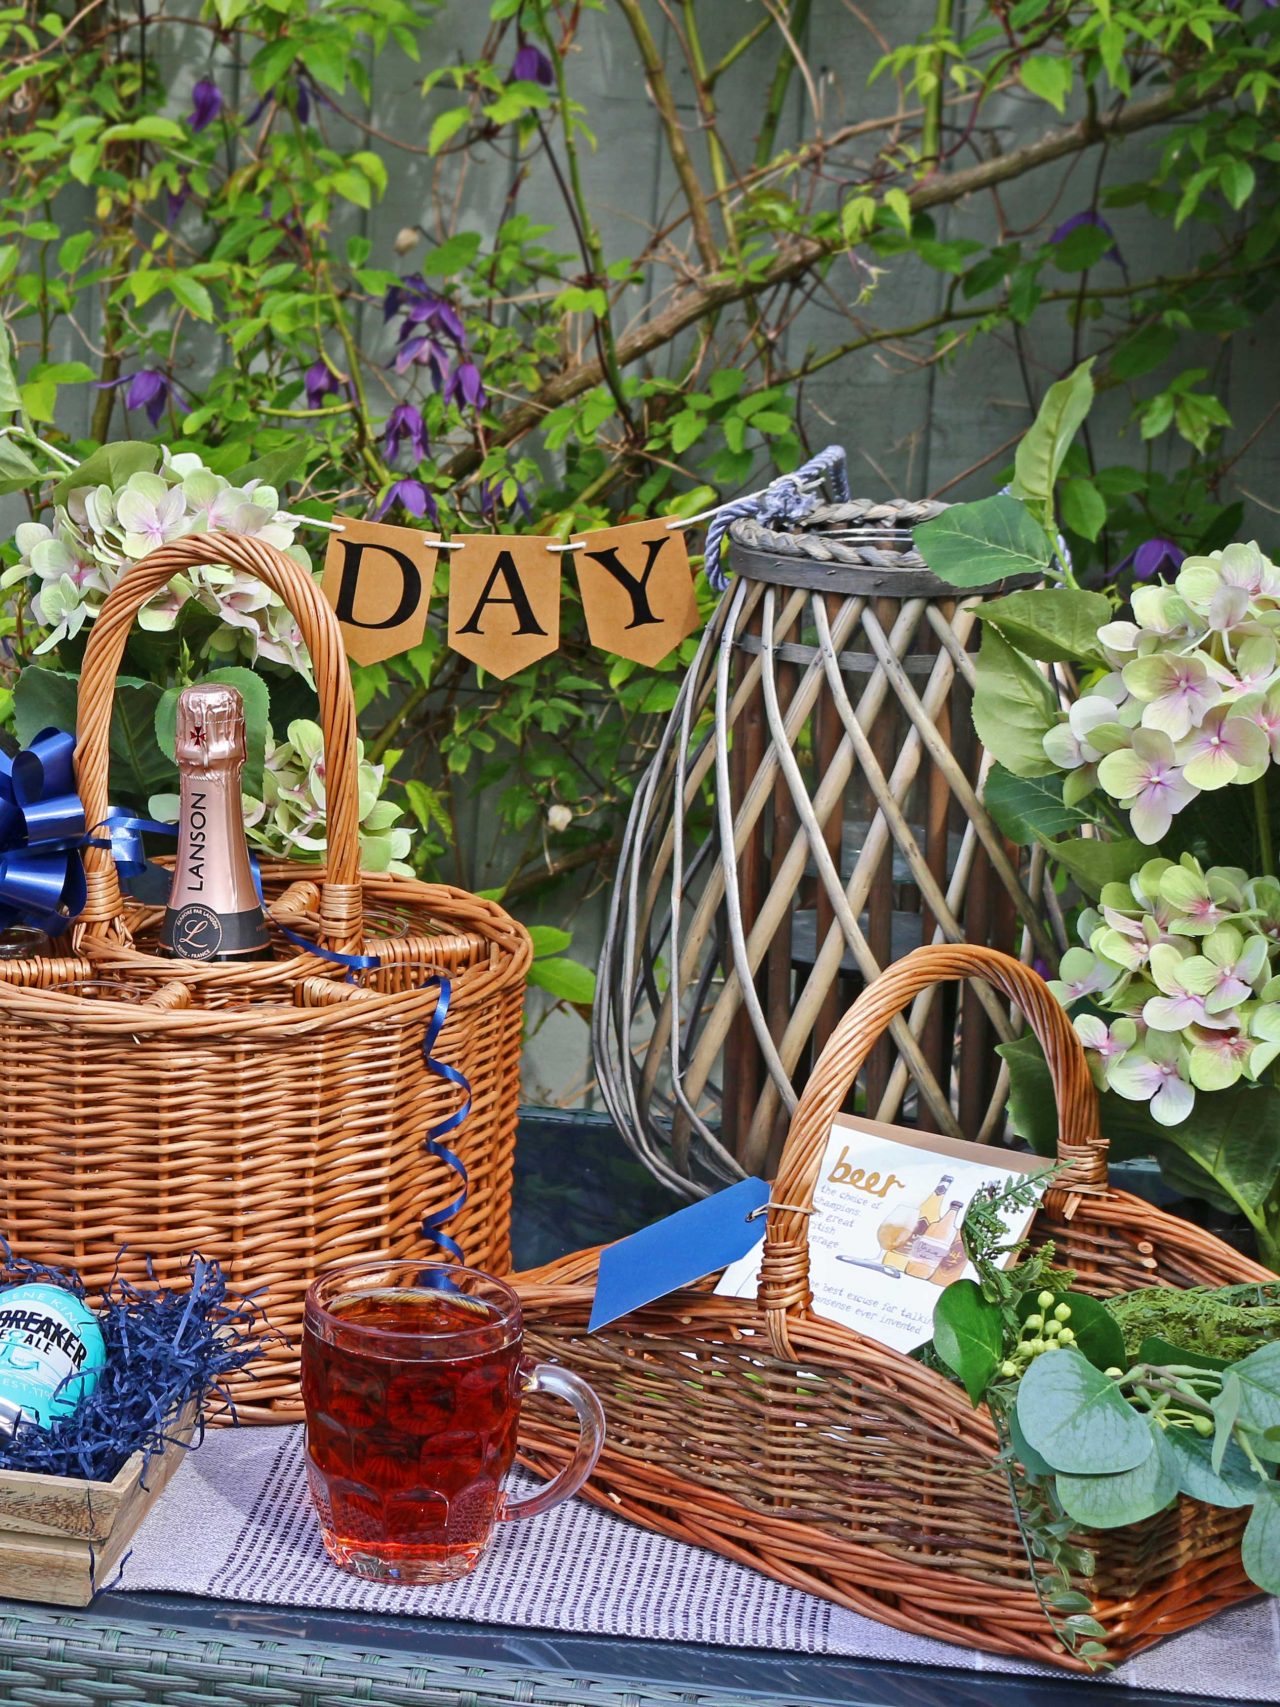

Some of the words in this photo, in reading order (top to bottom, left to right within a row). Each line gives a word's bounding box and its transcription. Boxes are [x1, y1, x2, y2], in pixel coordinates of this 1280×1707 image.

[335, 536, 670, 636] DAY
[187, 792, 207, 891] LANSON
[827, 1145, 905, 1198] beer
[23, 1334, 54, 1355] ALE
